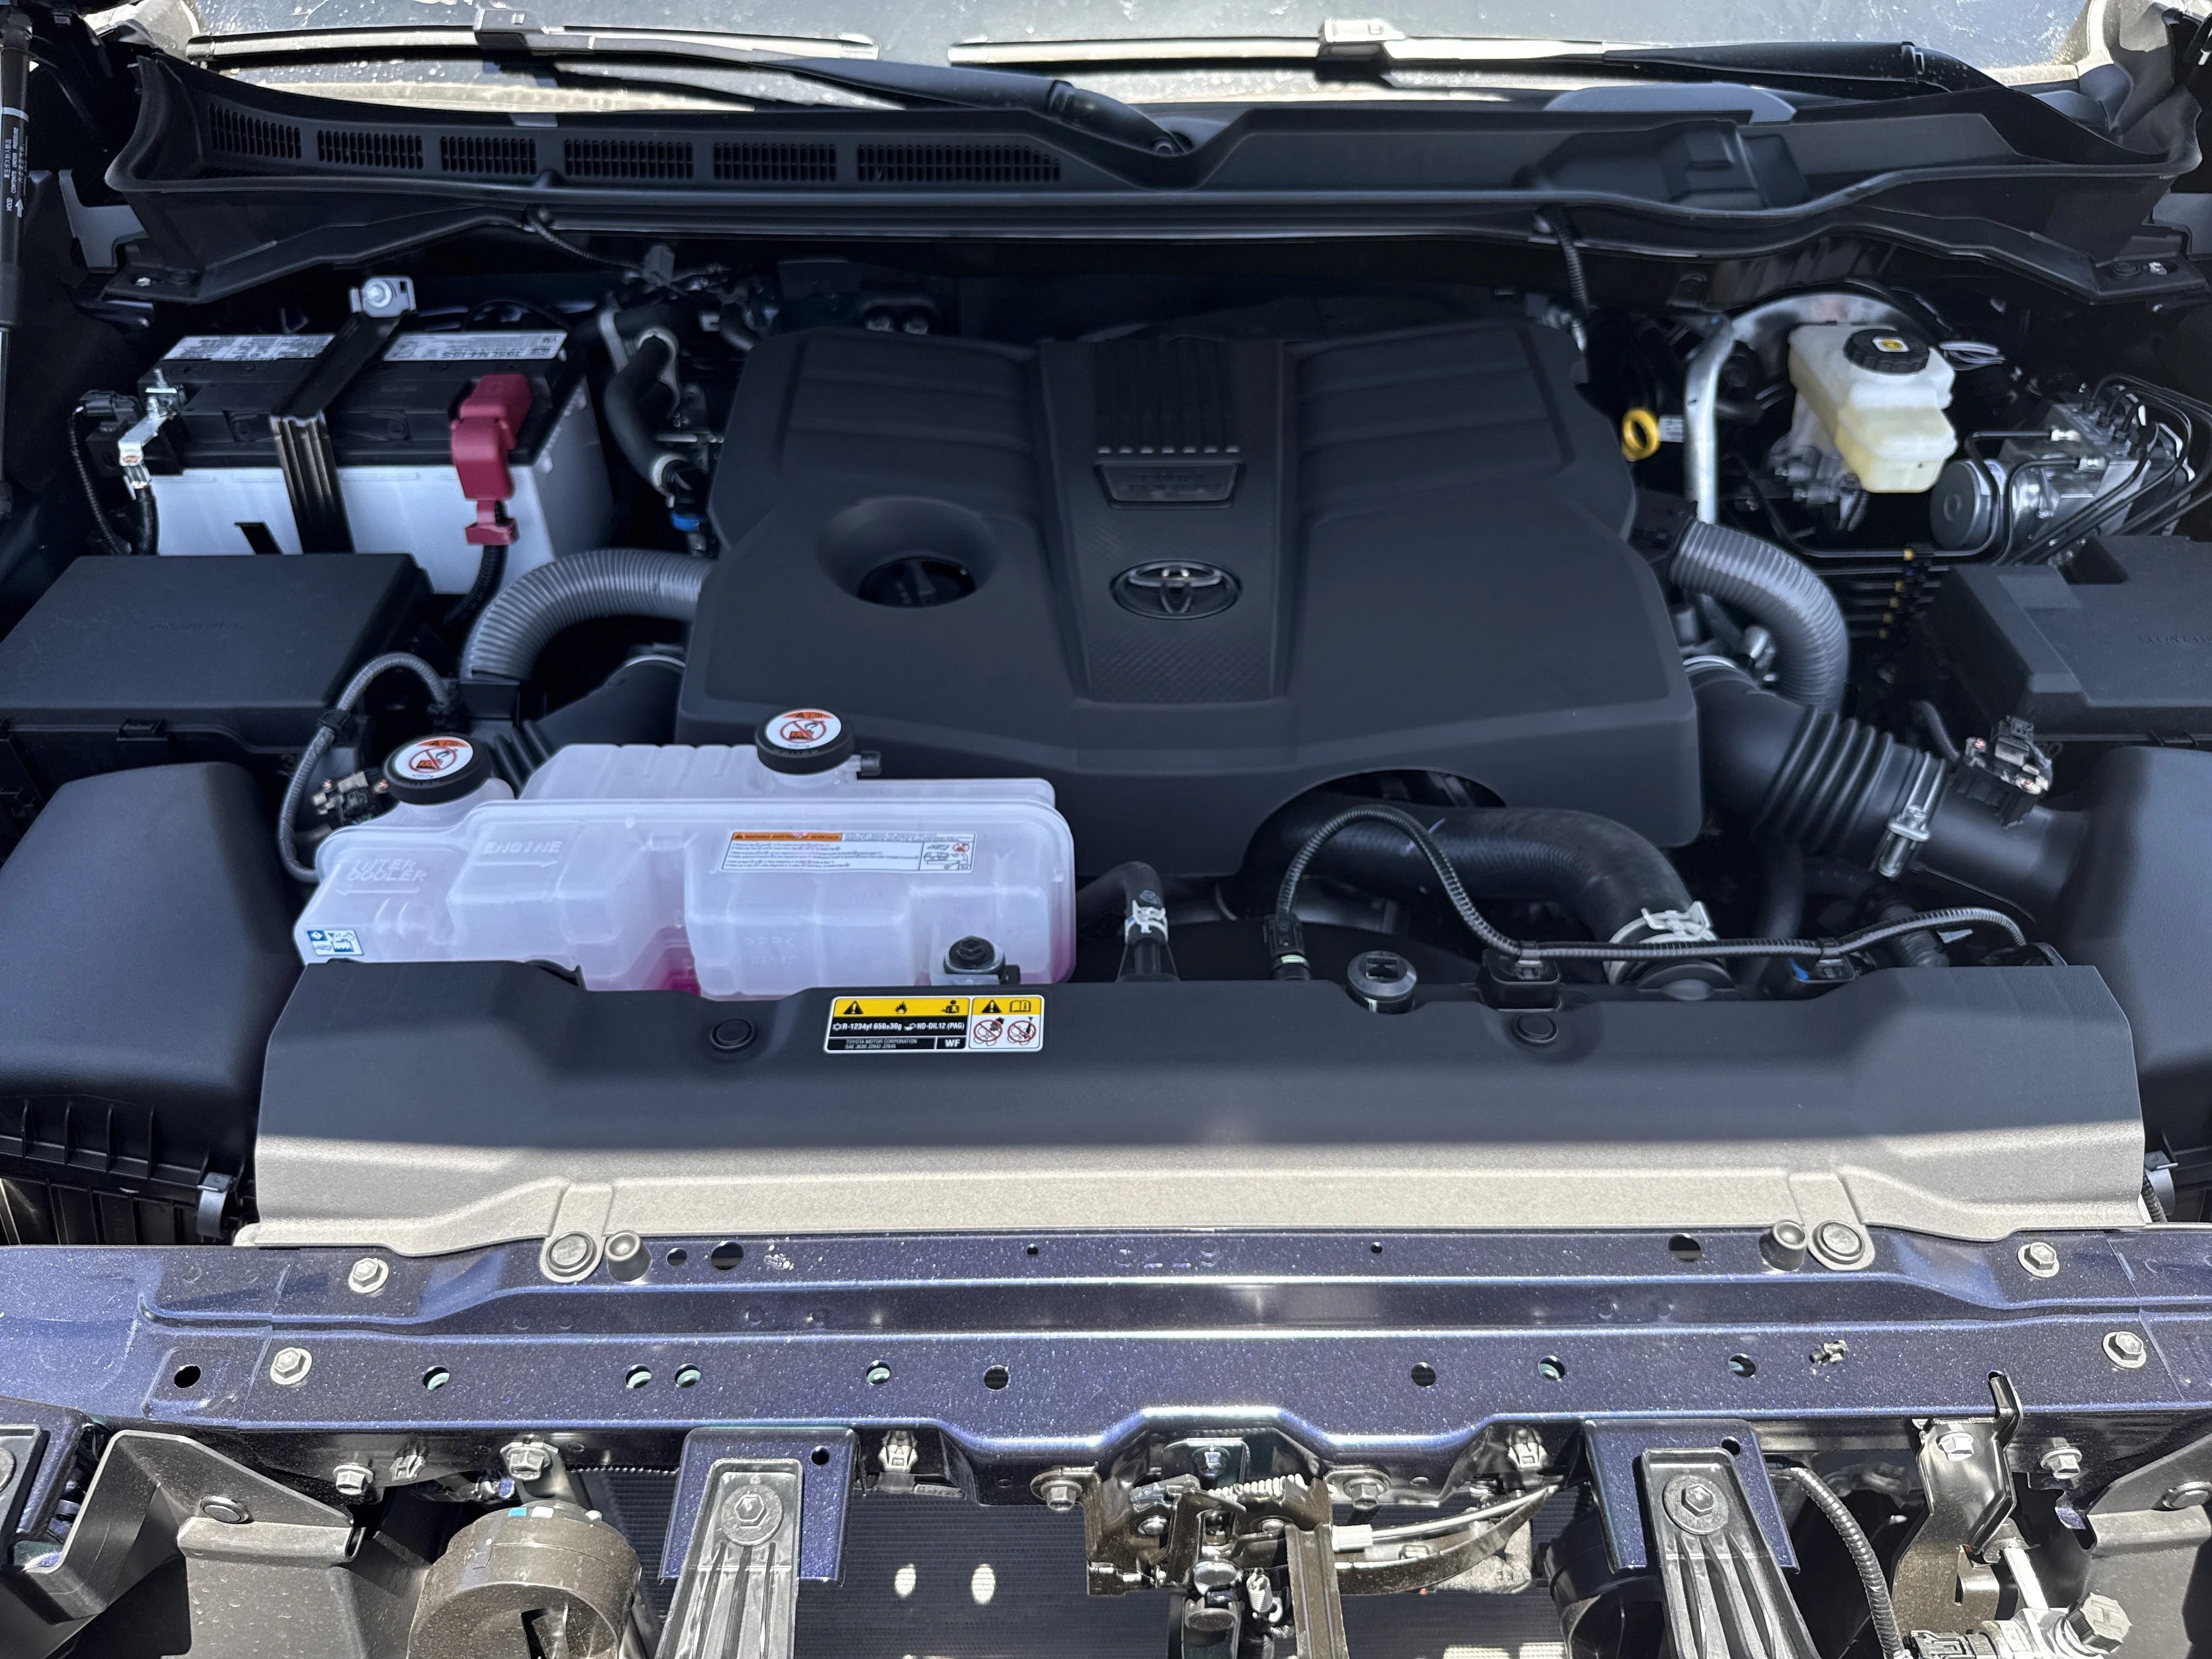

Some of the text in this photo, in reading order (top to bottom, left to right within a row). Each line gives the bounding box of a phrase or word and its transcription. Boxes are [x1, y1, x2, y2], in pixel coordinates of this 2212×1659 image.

[485, 840, 563, 854] ENGINE
[352, 859, 417, 871] INTER
[346, 870, 427, 882] COOLER
[842, 1023, 872, 1031] R-1234yf
[873, 1023, 902, 1031] 650±30g
[947, 1022, 965, 1030] (PAG)
[945, 1039, 961, 1047] WF
